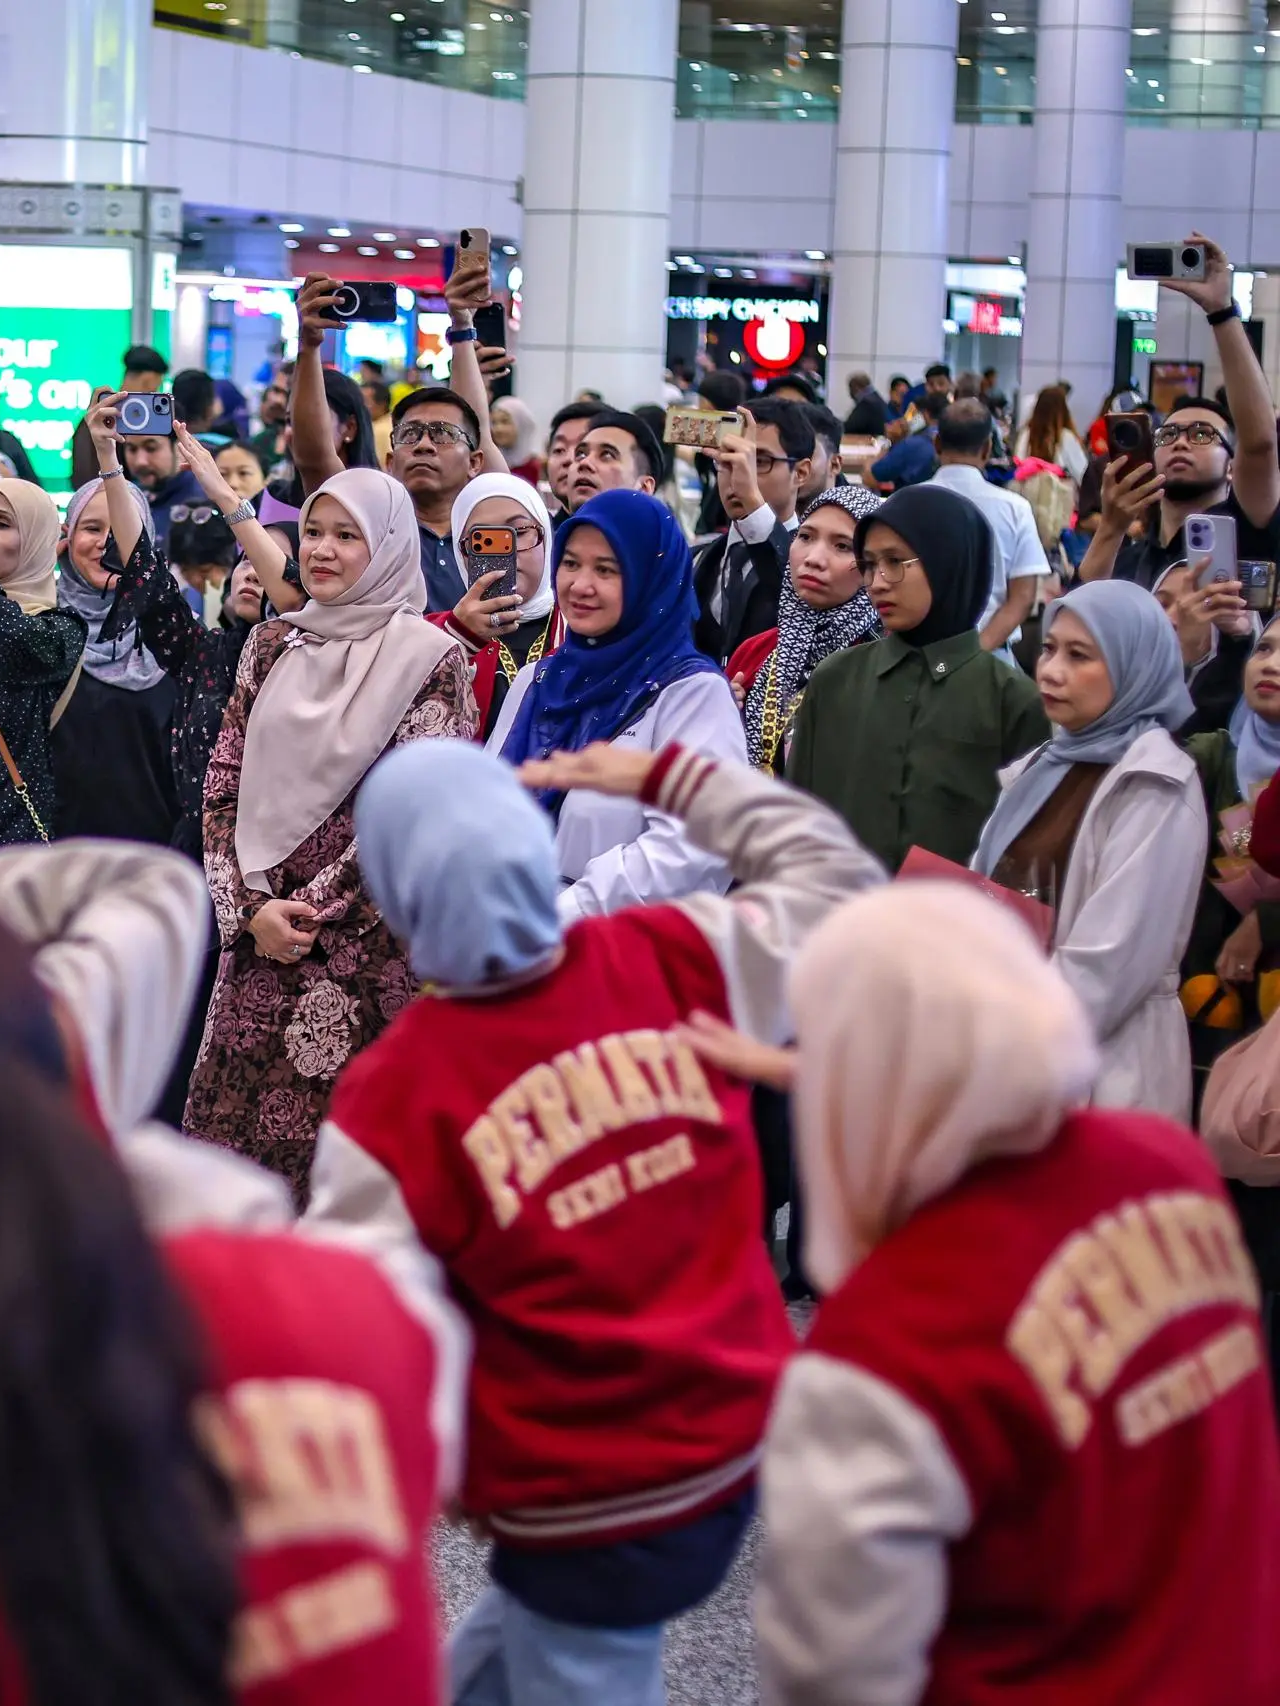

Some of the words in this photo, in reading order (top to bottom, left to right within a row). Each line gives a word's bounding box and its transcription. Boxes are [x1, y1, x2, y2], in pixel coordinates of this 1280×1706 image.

[664, 296, 731, 320] CRISPY
[732, 297, 819, 322] CHICKEN
[38, 380, 93, 410] on
[461, 1027, 724, 1231] PERMATA
[546, 1163, 627, 1230] SENI
[1005, 1190, 1261, 1452] PERMATA
